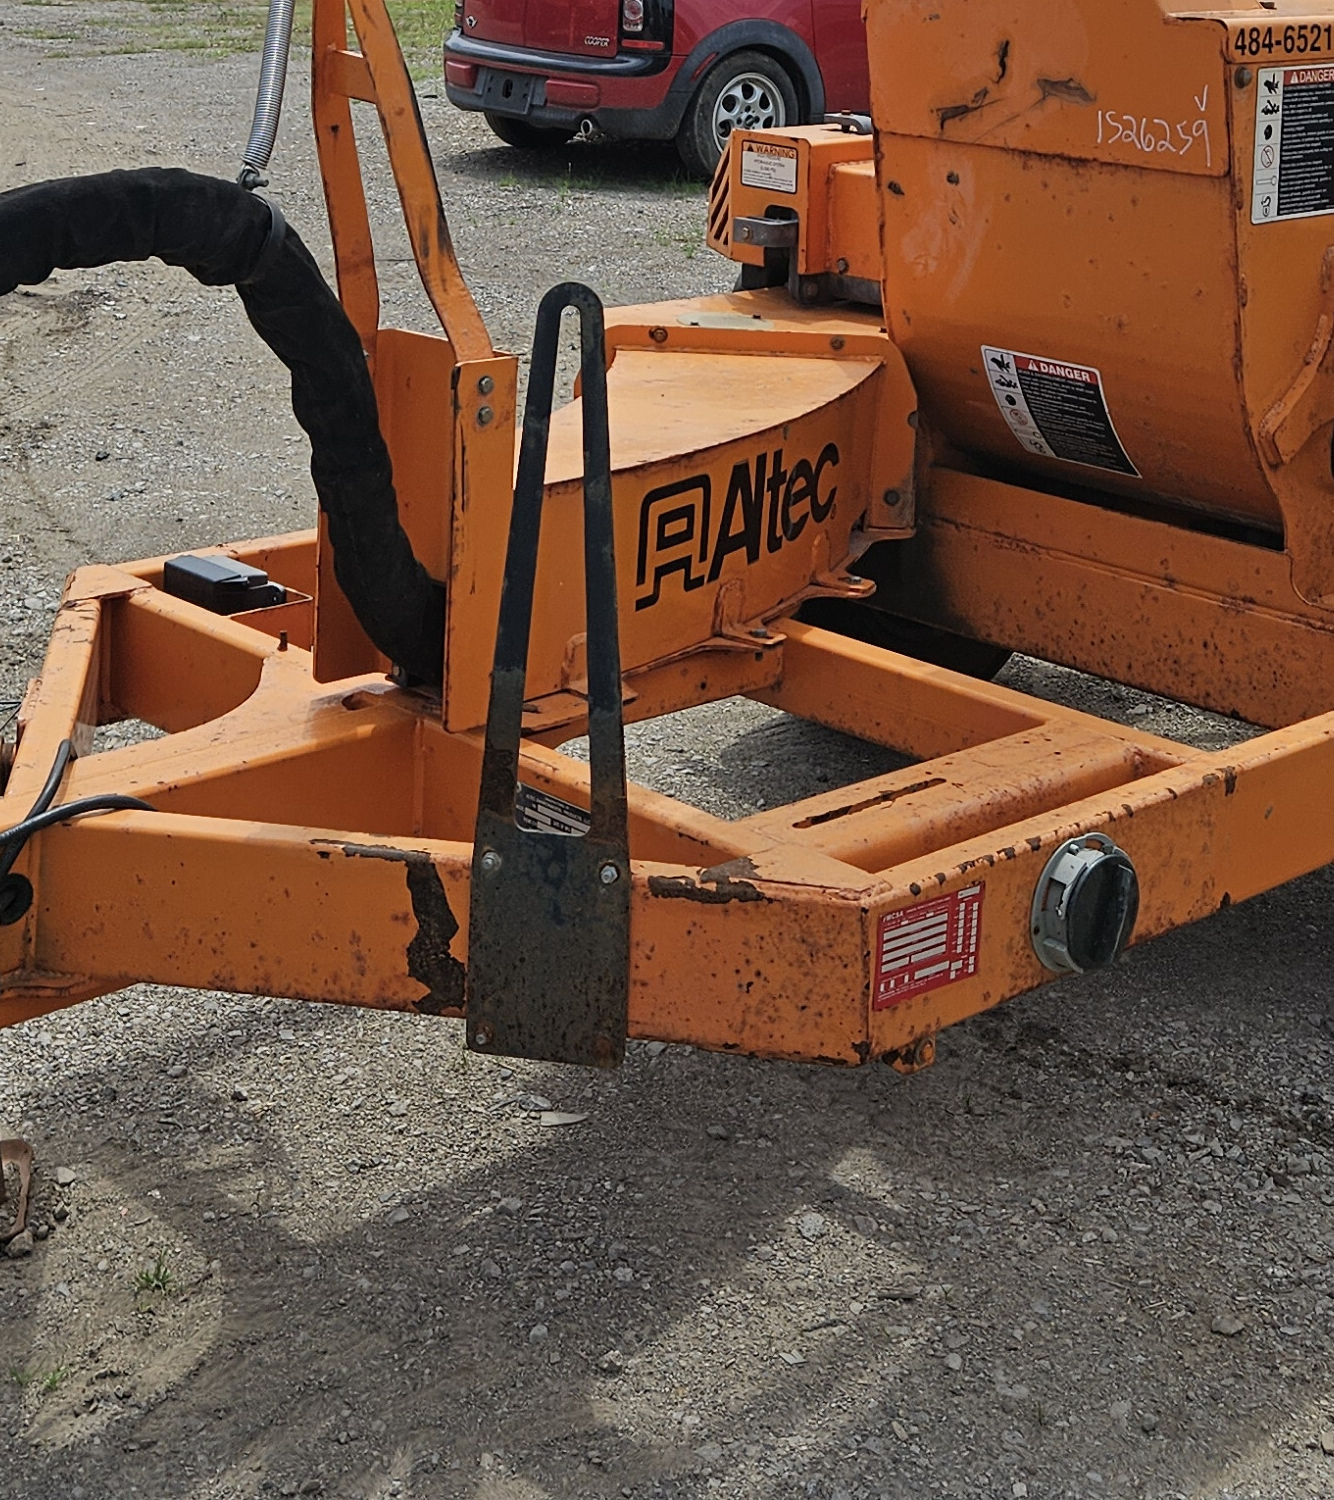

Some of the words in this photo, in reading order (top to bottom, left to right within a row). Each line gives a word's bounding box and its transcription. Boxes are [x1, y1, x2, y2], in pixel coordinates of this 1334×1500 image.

[584, 36, 610, 47] COOPER
[1234, 24, 1333, 55] 484-6521
[1097, 110, 1211, 167] 1526259
[756, 145, 796, 159] WARNING
[1039, 362, 1091, 382] DANGER
[707, 442, 840, 584] Altec
